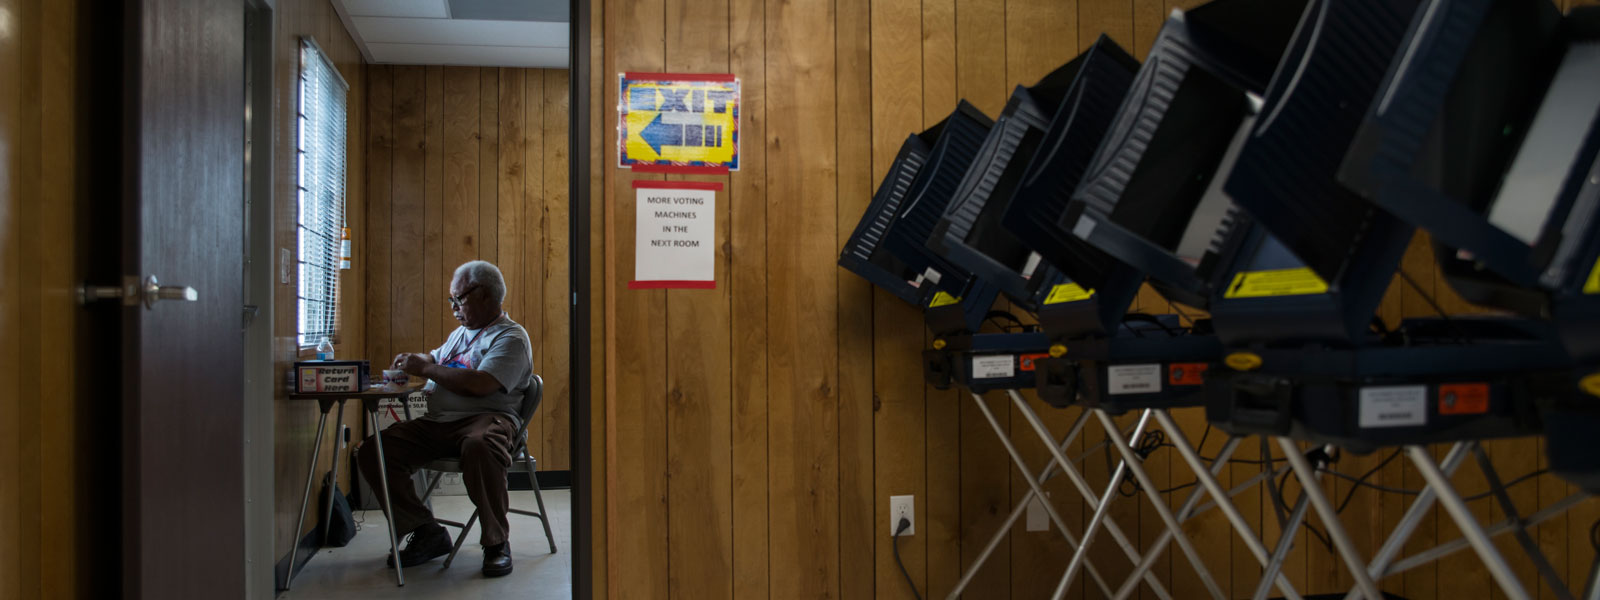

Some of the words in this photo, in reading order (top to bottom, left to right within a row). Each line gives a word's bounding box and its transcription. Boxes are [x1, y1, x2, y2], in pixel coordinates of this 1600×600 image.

[630, 87, 735, 113] EXIT
[673, 197, 704, 205] VOTING
[654, 211, 697, 219] MACHINES
[662, 225, 671, 233] IN
[673, 225, 688, 233] THE
[673, 240, 699, 248] ROOM
